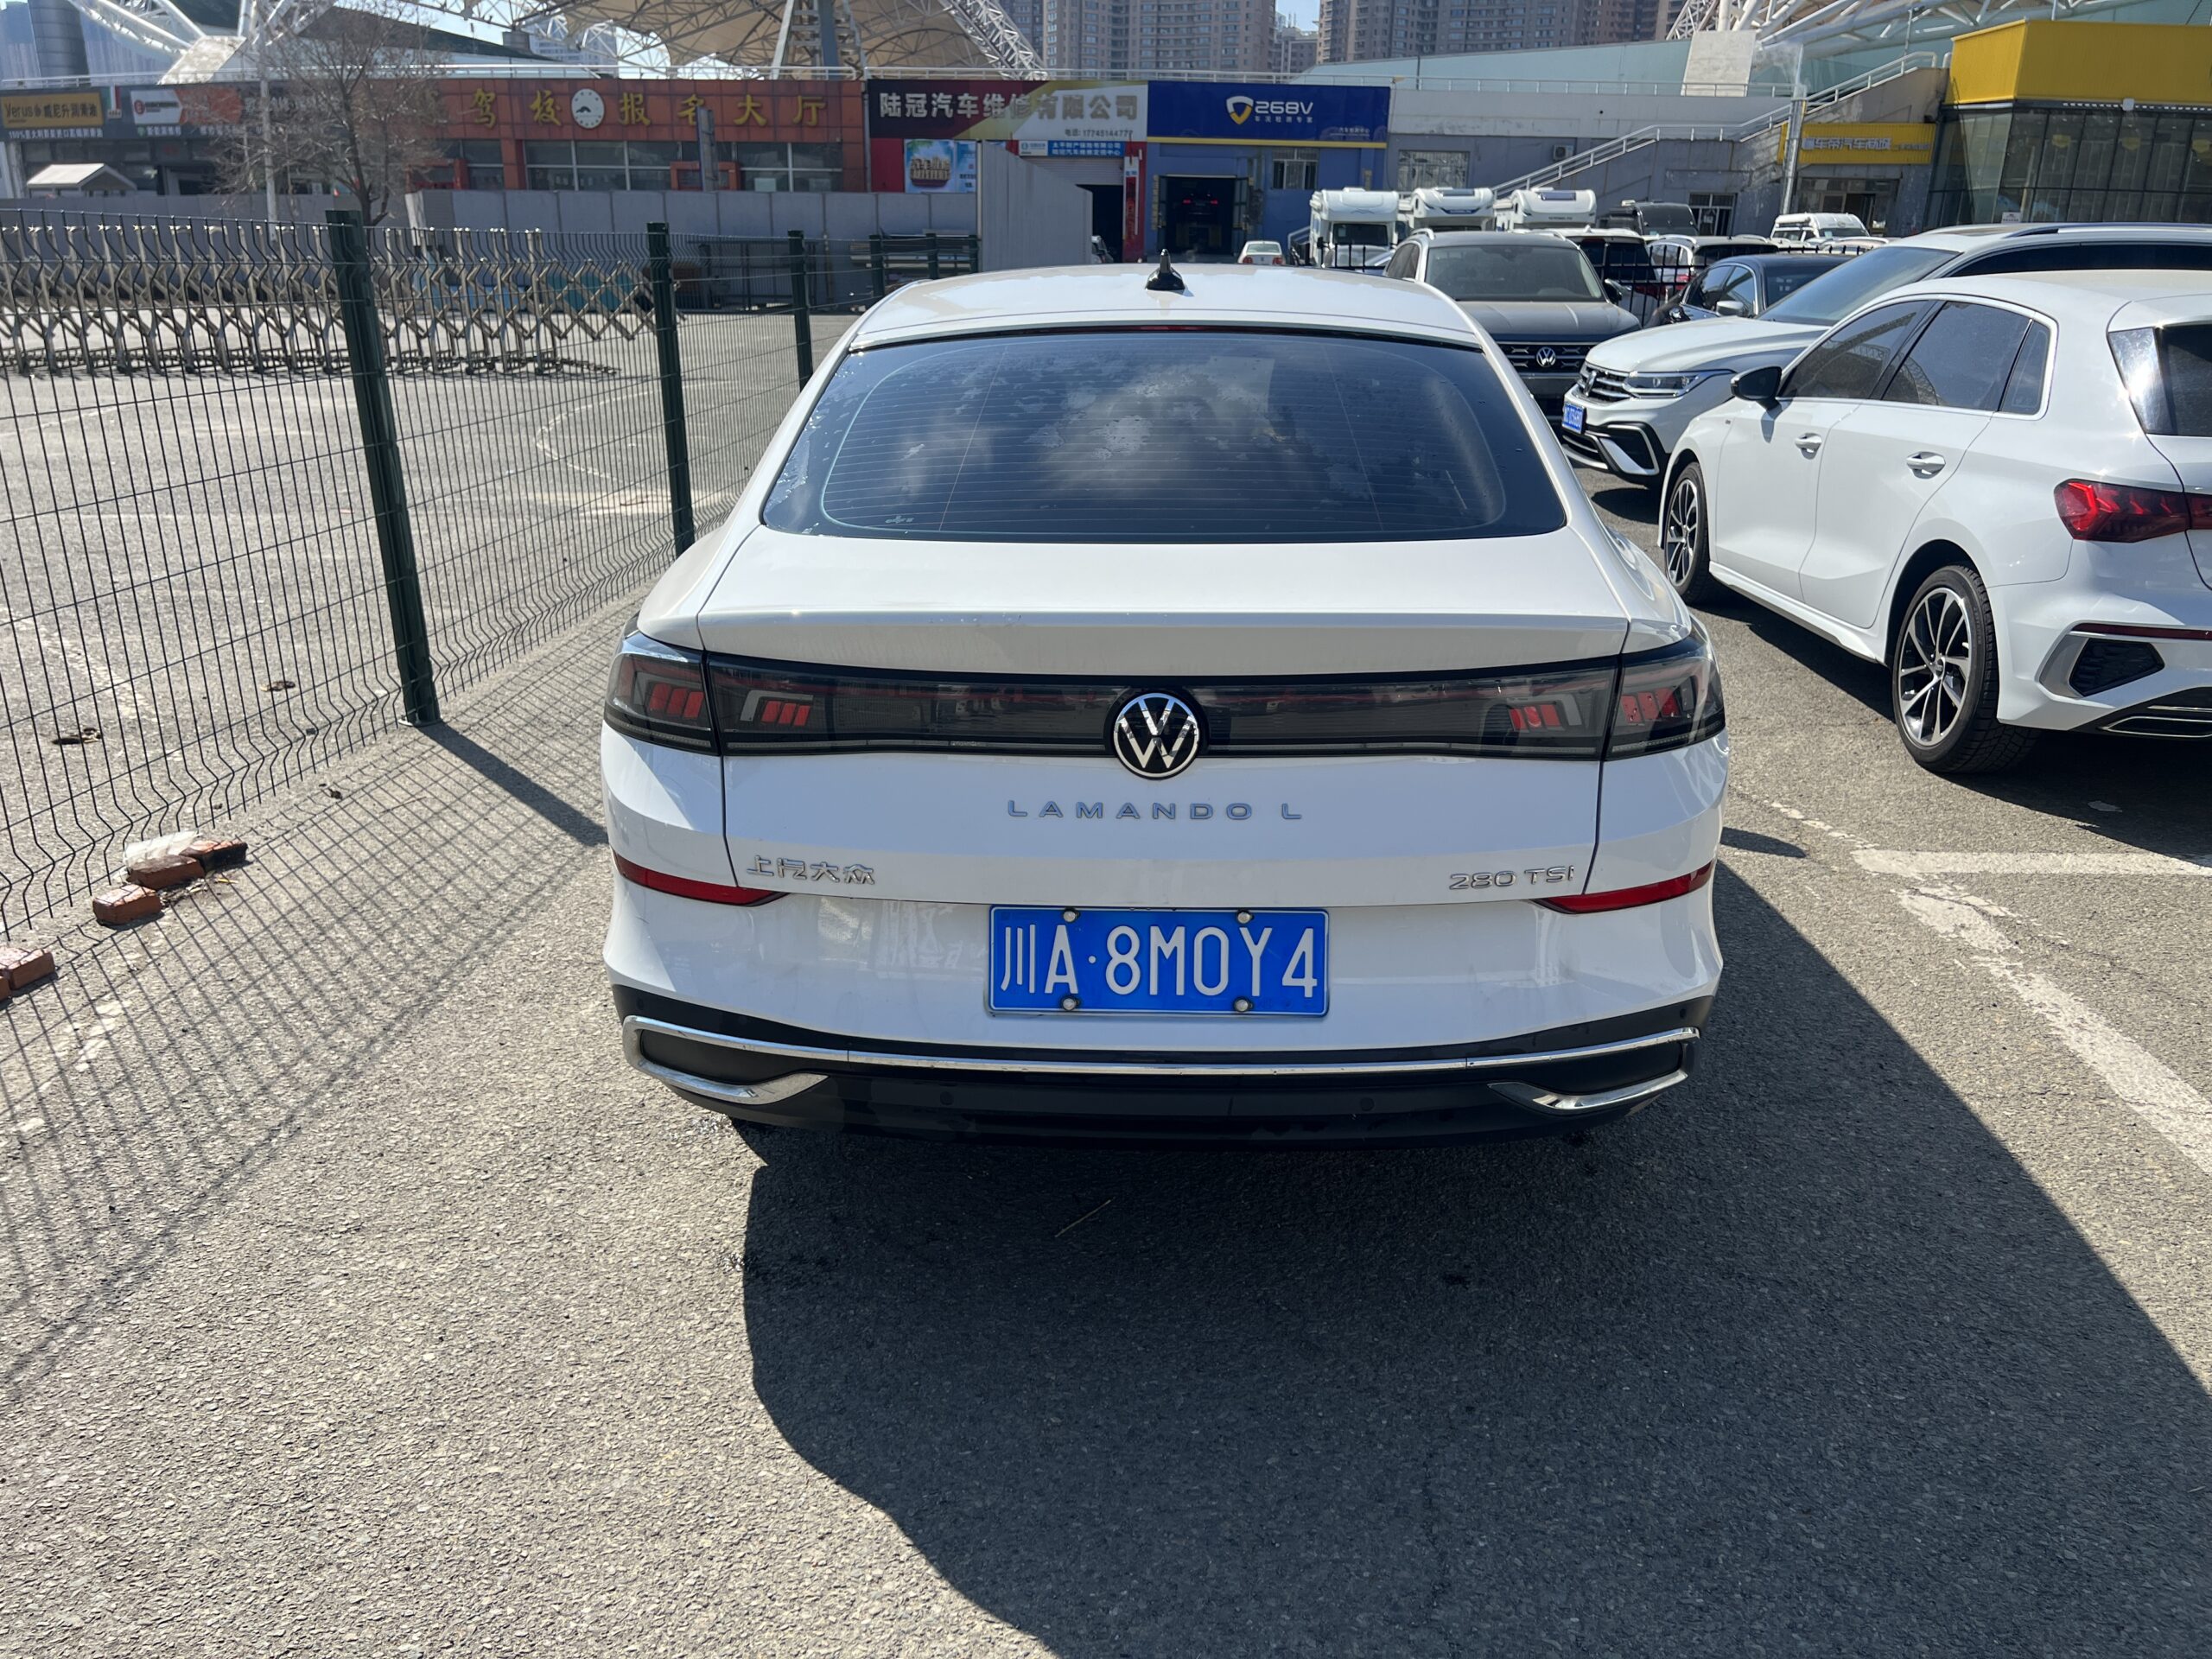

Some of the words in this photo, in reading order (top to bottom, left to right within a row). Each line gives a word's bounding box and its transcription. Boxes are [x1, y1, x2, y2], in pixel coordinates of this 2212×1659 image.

[879, 92, 1138, 119] 陆冠汽车维修有限公司
[1255, 100, 1314, 114] 268V
[1007, 799, 1253, 821] LAMANDO
[1281, 802, 1302, 820] L
[746, 855, 876, 886] 上汽大众
[1448, 870, 1516, 891] 280
